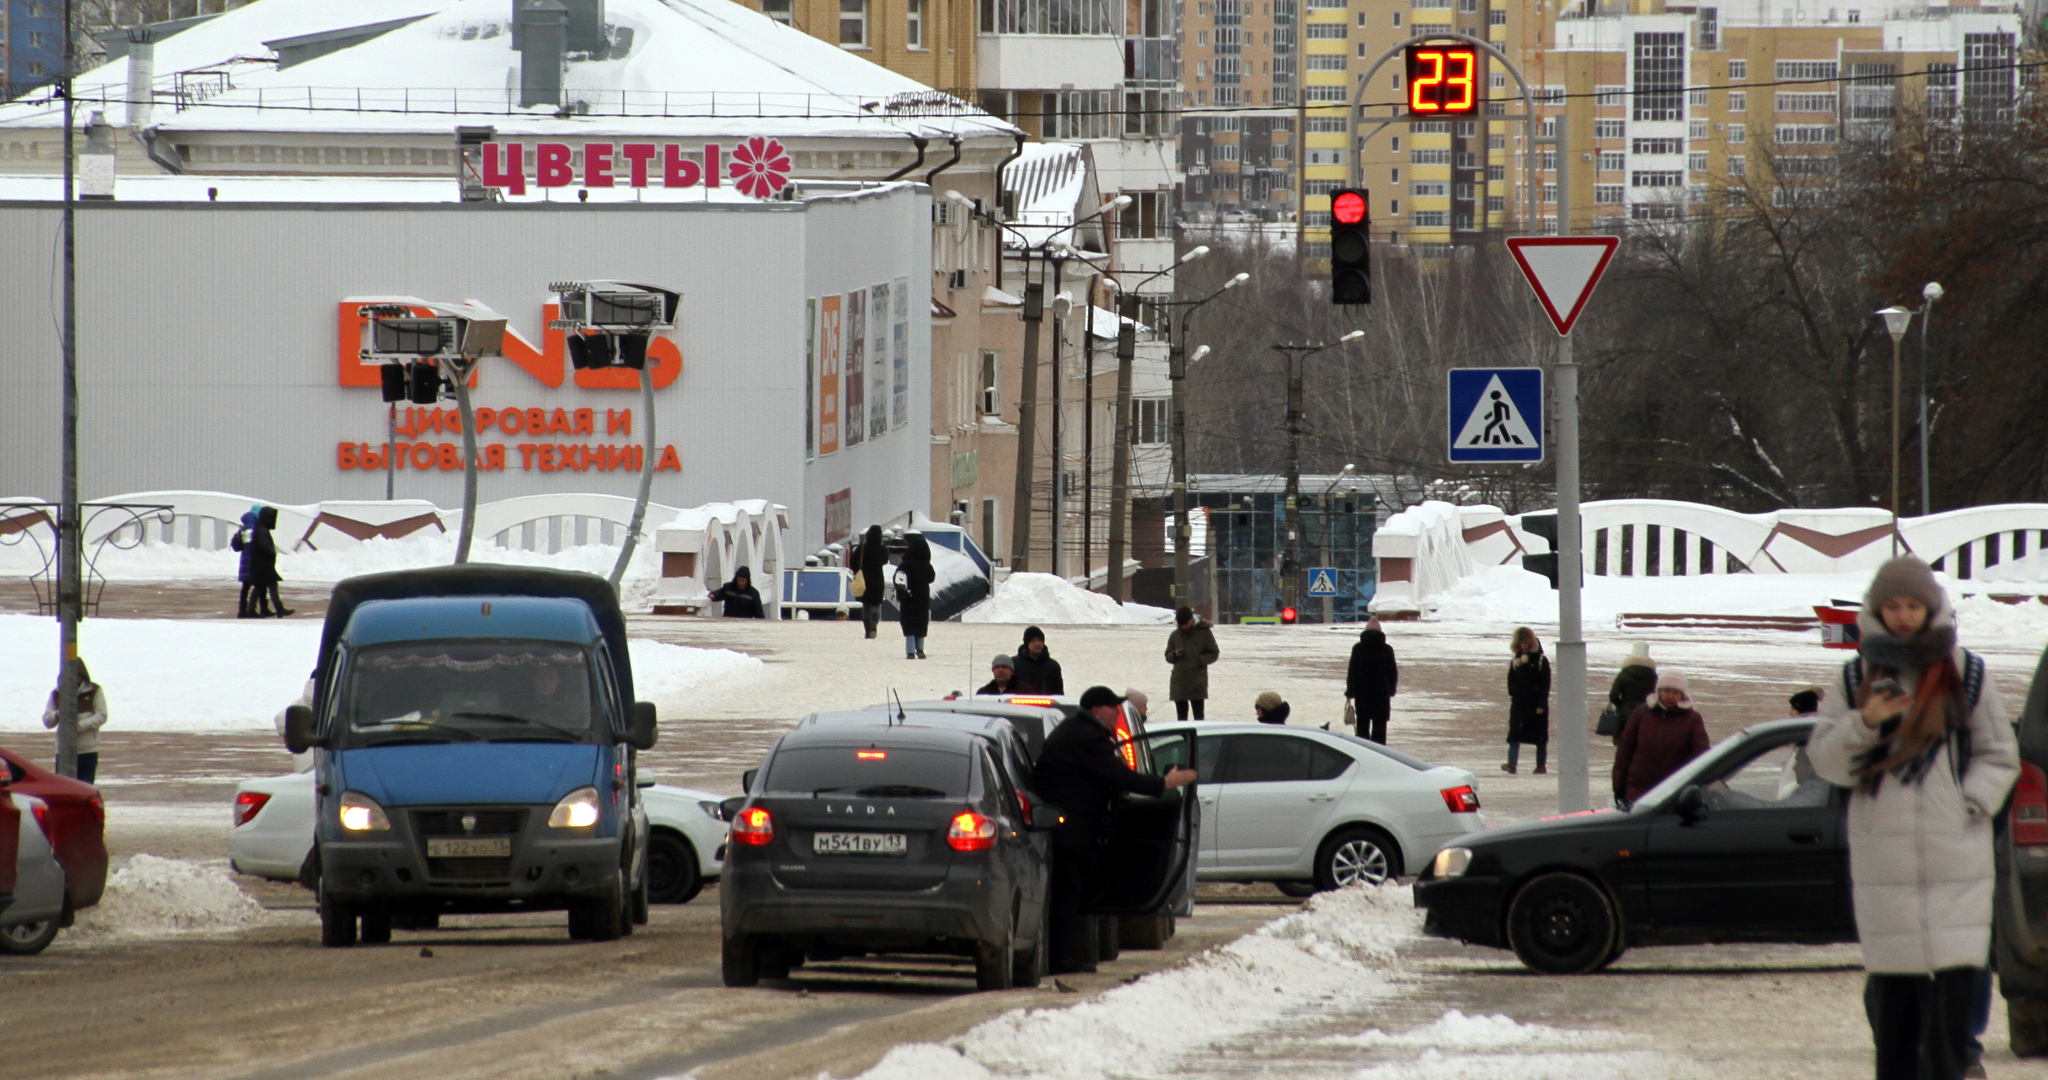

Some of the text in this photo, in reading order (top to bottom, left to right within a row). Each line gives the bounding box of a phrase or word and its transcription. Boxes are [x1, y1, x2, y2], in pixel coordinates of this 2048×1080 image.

[1411, 51, 1475, 111] 23
[482, 142, 720, 195] ЦВЕТЫ
[607, 408, 632, 436] И
[827, 804, 895, 814] LADA
[888, 836, 901, 846] 13
